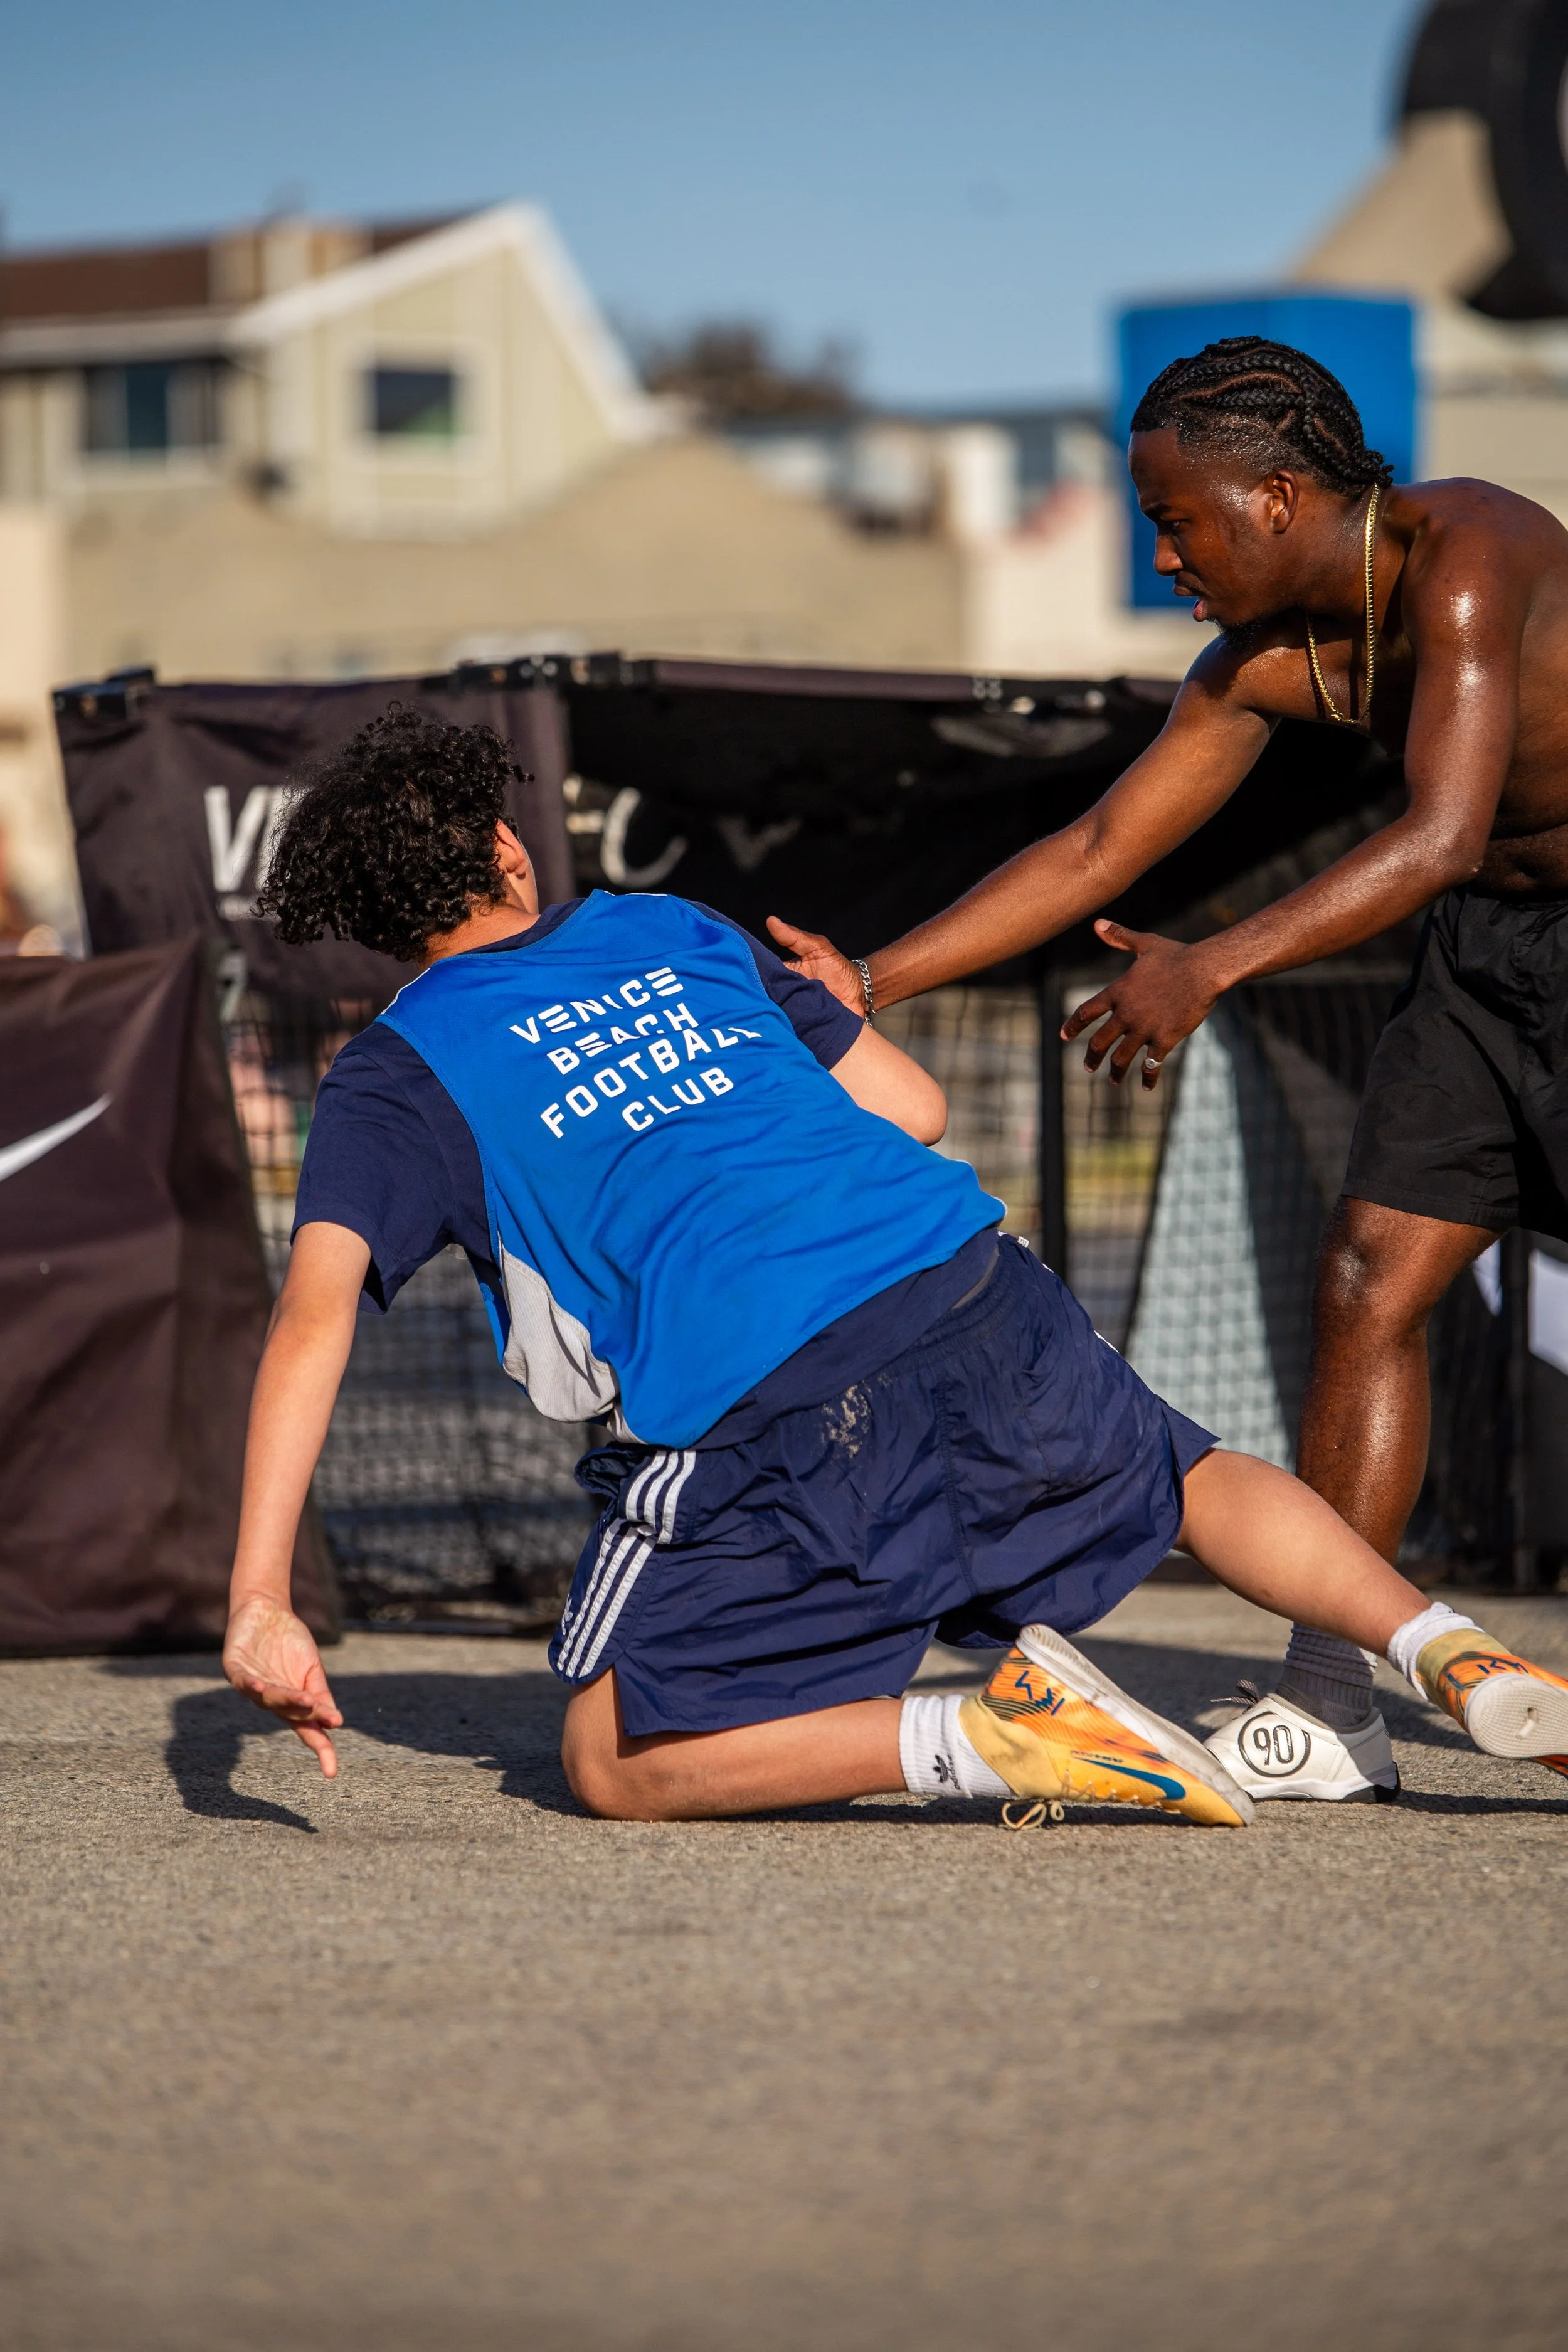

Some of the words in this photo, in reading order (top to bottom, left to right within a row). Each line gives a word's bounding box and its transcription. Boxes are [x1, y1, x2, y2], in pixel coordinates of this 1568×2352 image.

[509, 967, 684, 1044] VENICE
[546, 1002, 699, 1075] BEACH
[540, 1028, 762, 1139] FOOTBALL
[622, 1067, 734, 1131] CLUB
[1253, 1724, 1295, 1766] 90
